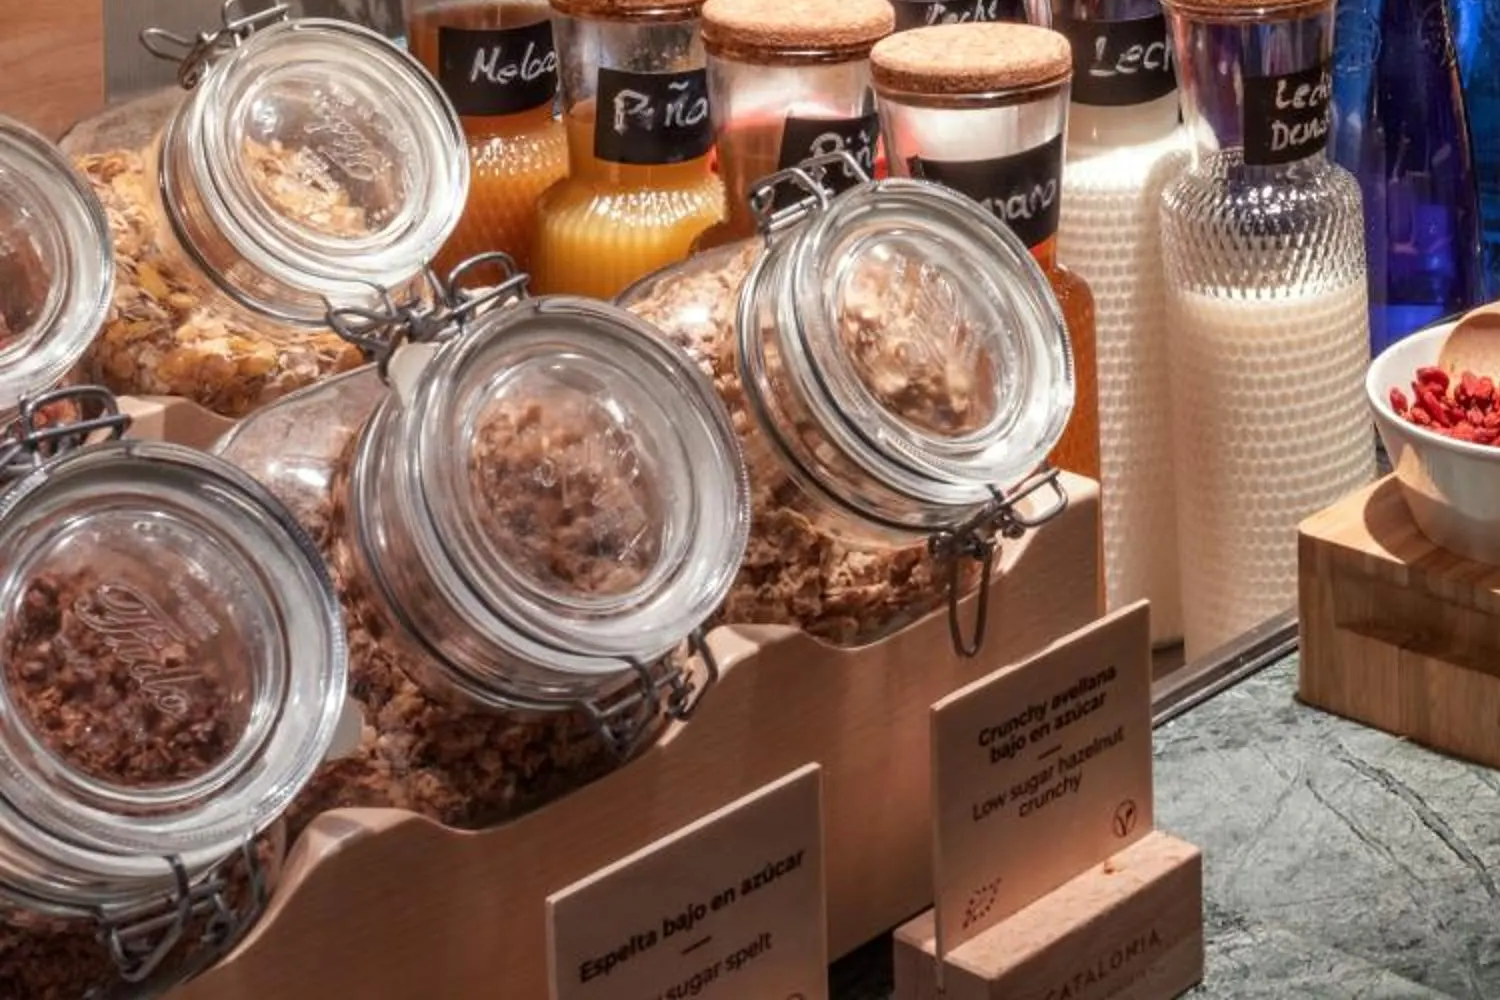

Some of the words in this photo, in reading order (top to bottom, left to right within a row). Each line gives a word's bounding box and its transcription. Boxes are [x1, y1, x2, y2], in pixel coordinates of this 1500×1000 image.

[978, 701, 1048, 748] Crunchy
[1051, 665, 1118, 710] avellana
[989, 734, 1027, 765] bajo
[1029, 722, 1051, 744] en
[972, 792, 1007, 822] Low
[1010, 765, 1054, 801] sugar
[1058, 725, 1125, 774] hazelnut
[1018, 771, 1083, 818] crunchy
[579, 927, 658, 984] Espelta
[662, 902, 707, 938] bajo
[710, 885, 737, 912] en
[740, 849, 806, 897] azúcar
[664, 960, 723, 1000] sugar
[725, 931, 773, 972] spelt
